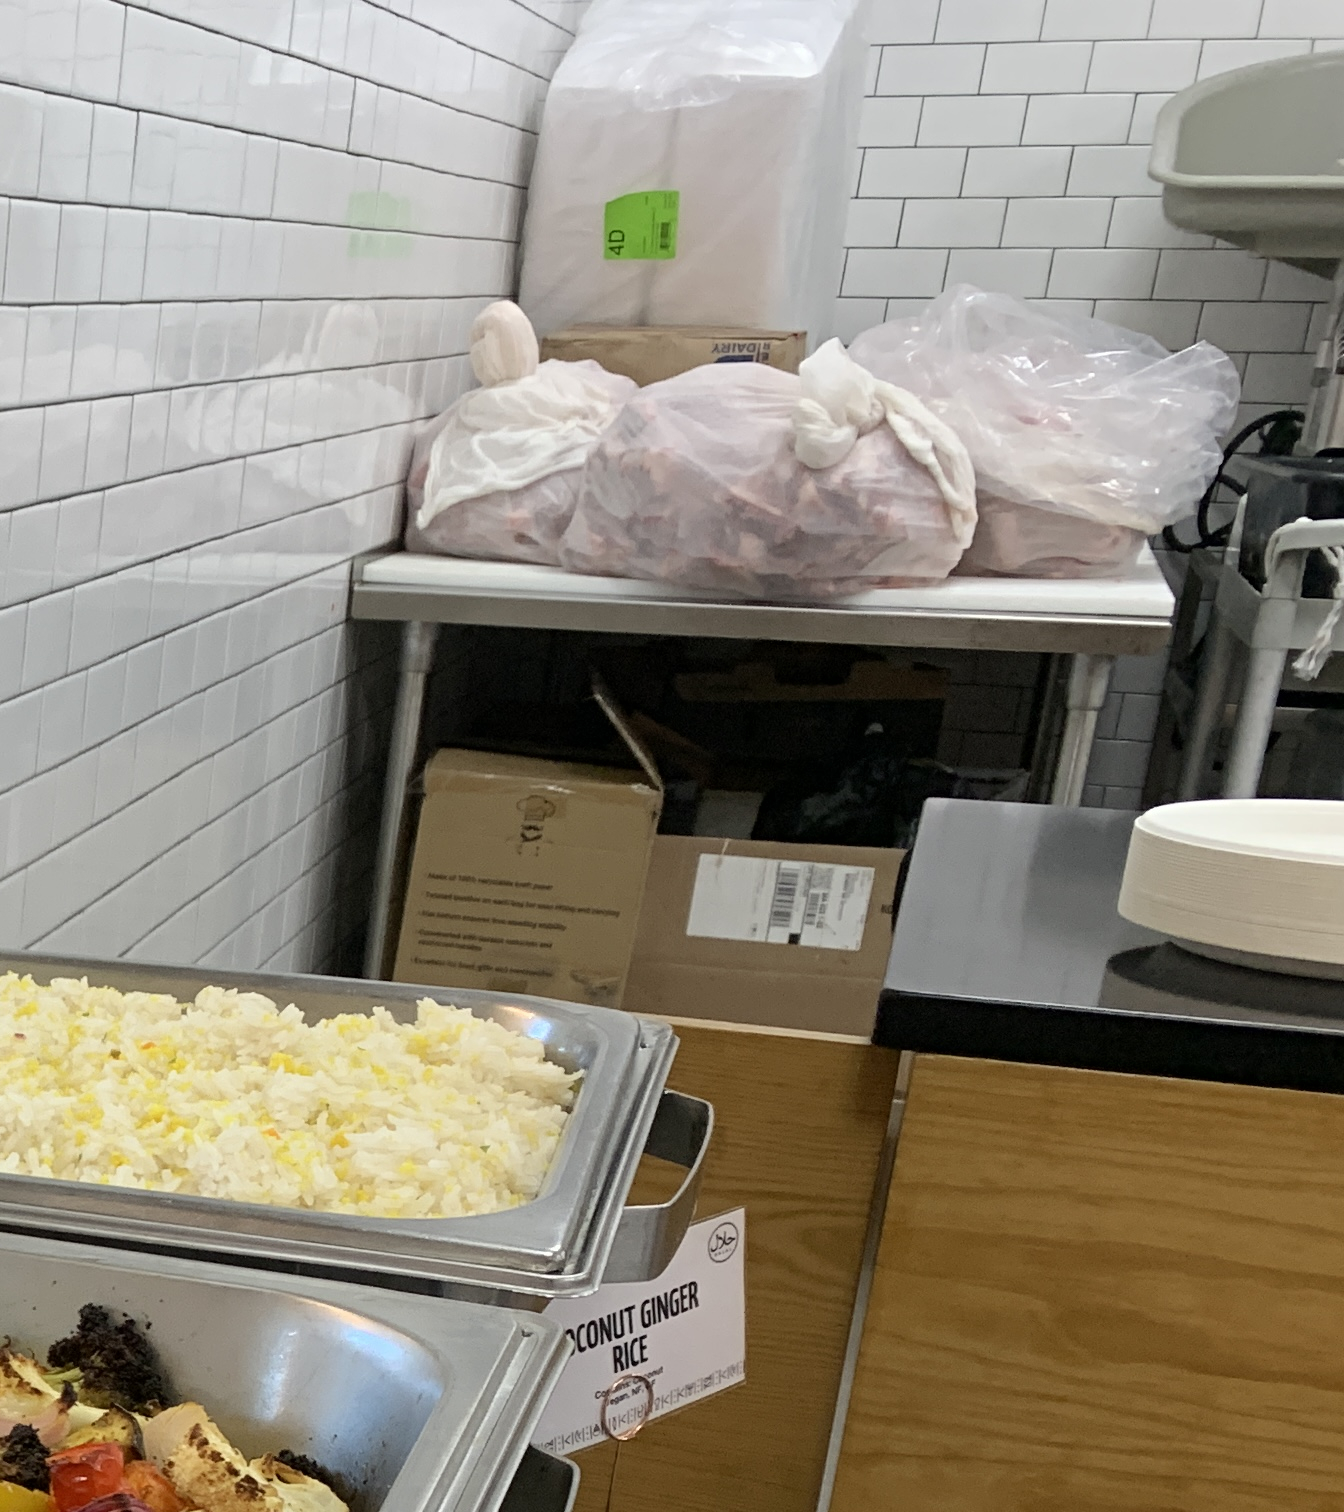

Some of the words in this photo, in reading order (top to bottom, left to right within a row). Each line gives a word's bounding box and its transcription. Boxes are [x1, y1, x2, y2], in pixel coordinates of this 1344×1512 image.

[607, 229, 625, 256] 4D
[712, 342, 757, 354] DAIRY
[710, 1230, 736, 1253] حلال
[565, 1304, 636, 1357] OCONUT
[640, 1280, 700, 1329] GINGER
[612, 1334, 649, 1374] RICE
